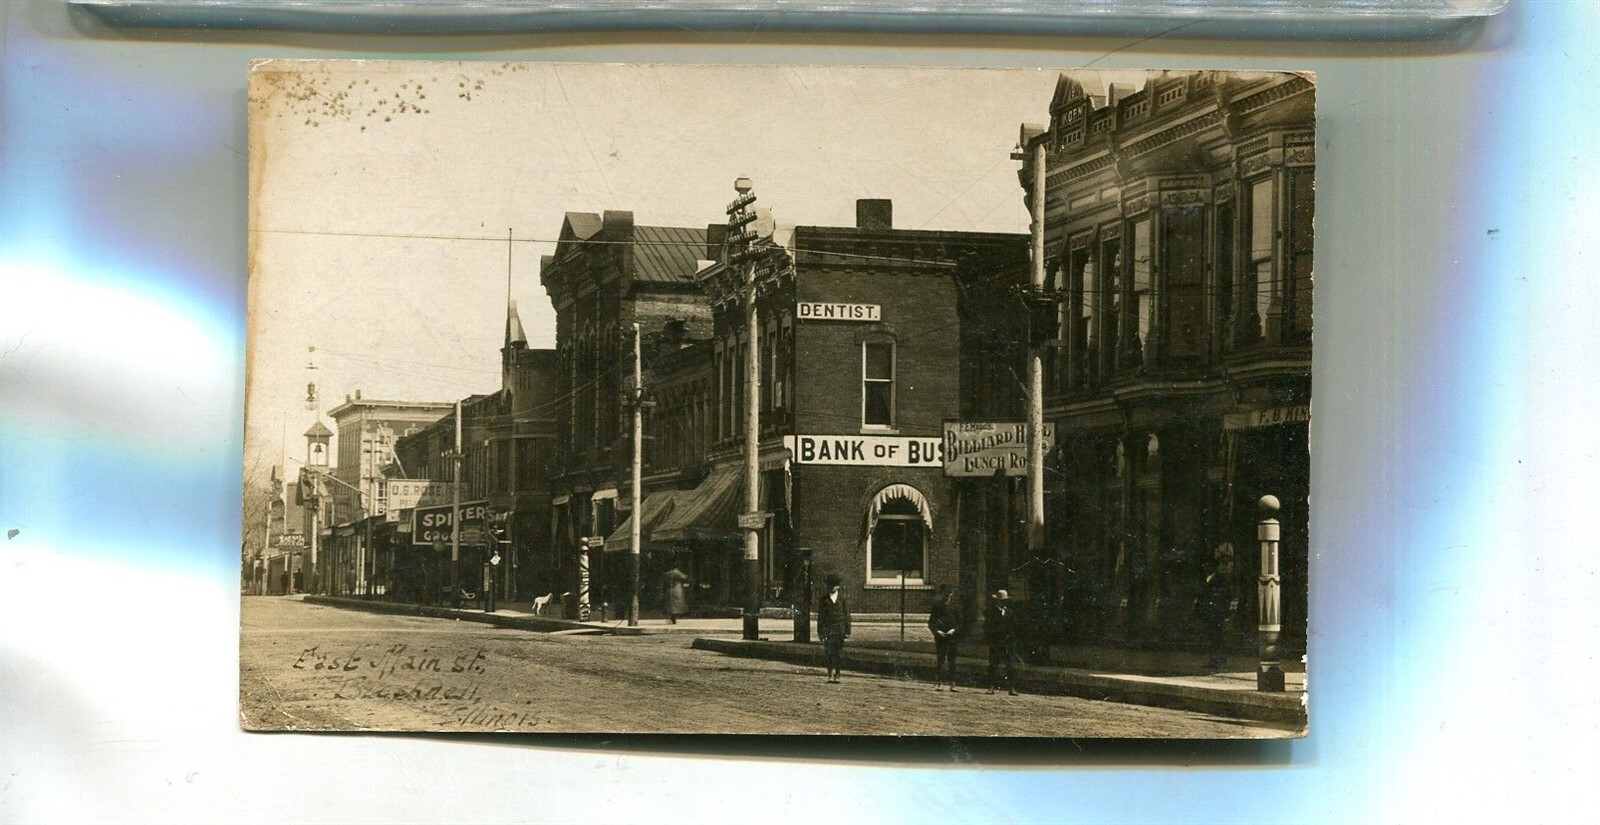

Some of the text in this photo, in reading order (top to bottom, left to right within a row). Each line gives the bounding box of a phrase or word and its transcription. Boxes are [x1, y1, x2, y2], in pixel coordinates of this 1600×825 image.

[800, 303, 879, 319] DENTIST.
[801, 437, 865, 462] BANK
[873, 444, 900, 458] OF
[946, 429, 1013, 462] BILLIARD
[964, 455, 1005, 473] LUNCH
[292, 645, 362, 672] East
[369, 643, 441, 680] Main
